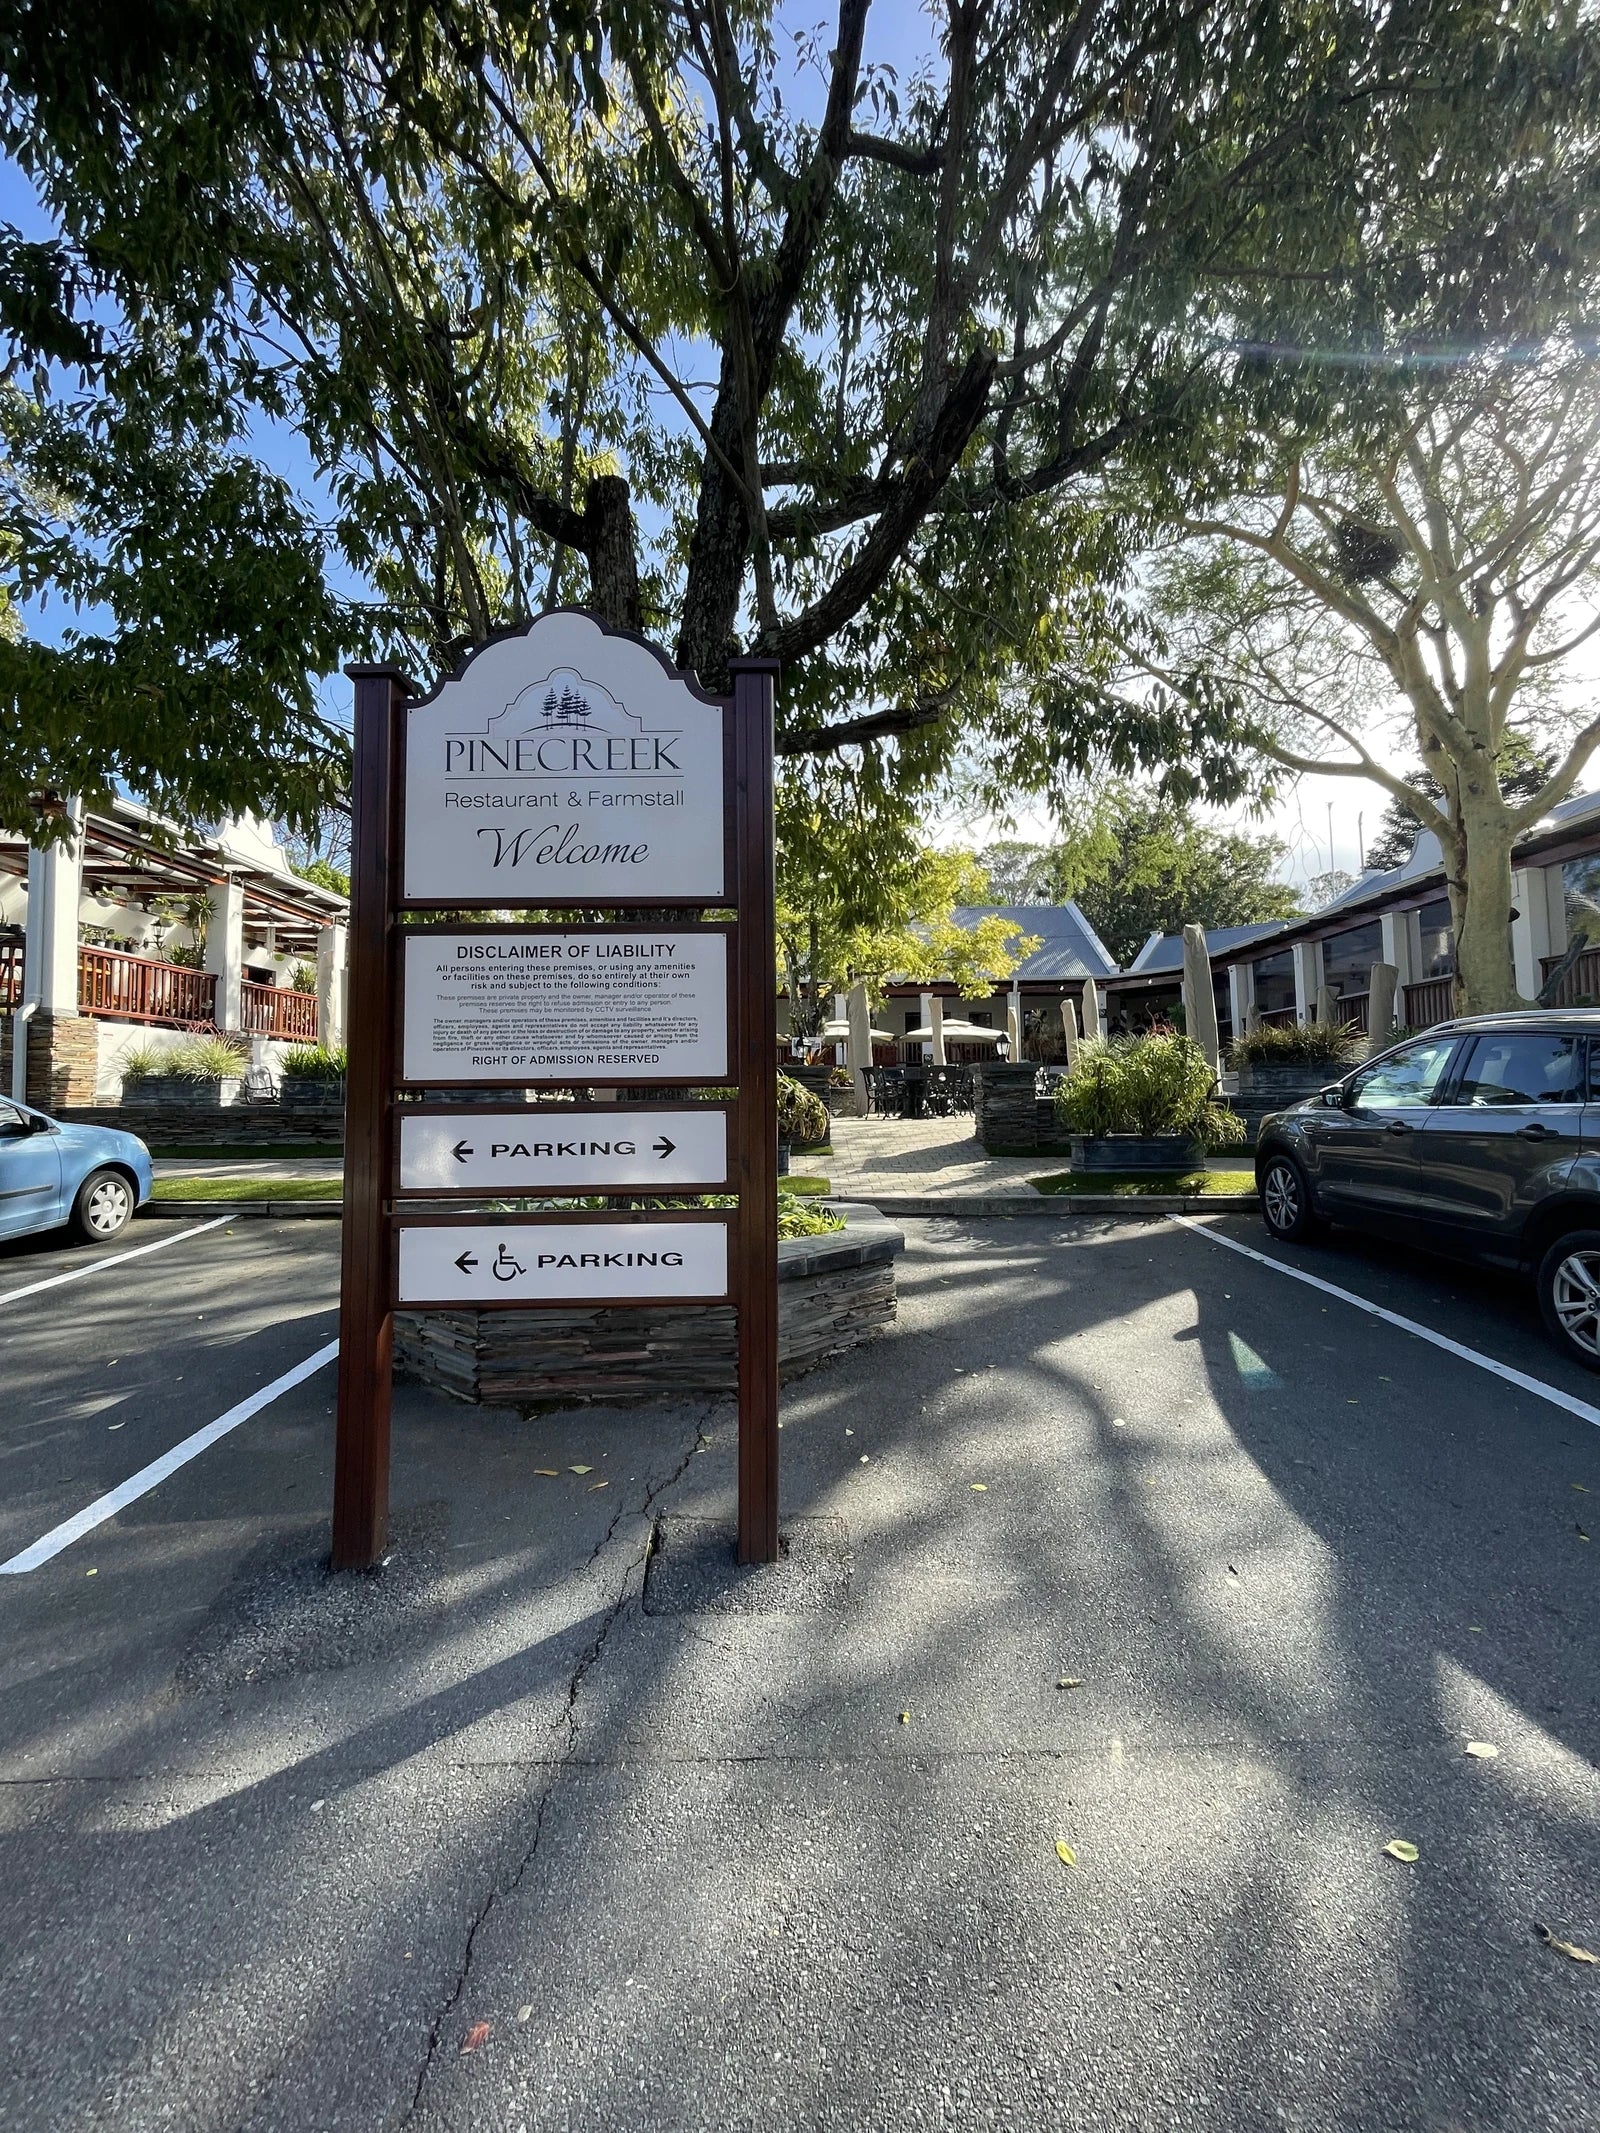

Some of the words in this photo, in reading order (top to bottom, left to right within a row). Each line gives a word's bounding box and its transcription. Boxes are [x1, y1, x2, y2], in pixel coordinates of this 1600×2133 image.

[444, 738, 683, 772] PINECREEK
[445, 792, 558, 808] Restaurant
[567, 791, 582, 807] &
[588, 790, 684, 806] Farmstall
[476, 823, 650, 868] Welcome
[457, 946, 562, 958] DISCLAIMER
[568, 945, 590, 958] OF
[596, 944, 676, 958] LIABILITY
[488, 964, 524, 973] entering
[553, 964, 596, 973] premises,
[610, 963, 634, 972] using
[533, 973, 576, 981] premises,
[604, 972, 637, 981] entirely
[508, 982, 540, 990] subject
[570, 982, 610, 990] following
[472, 1056, 508, 1065] RIGHT
[511, 1056, 526, 1064] OF
[530, 1055, 594, 1064] ADMISSION
[598, 1054, 660, 1064] RESERVED
[491, 1141, 636, 1158] PARKING
[538, 1252, 683, 1268] PARKING
